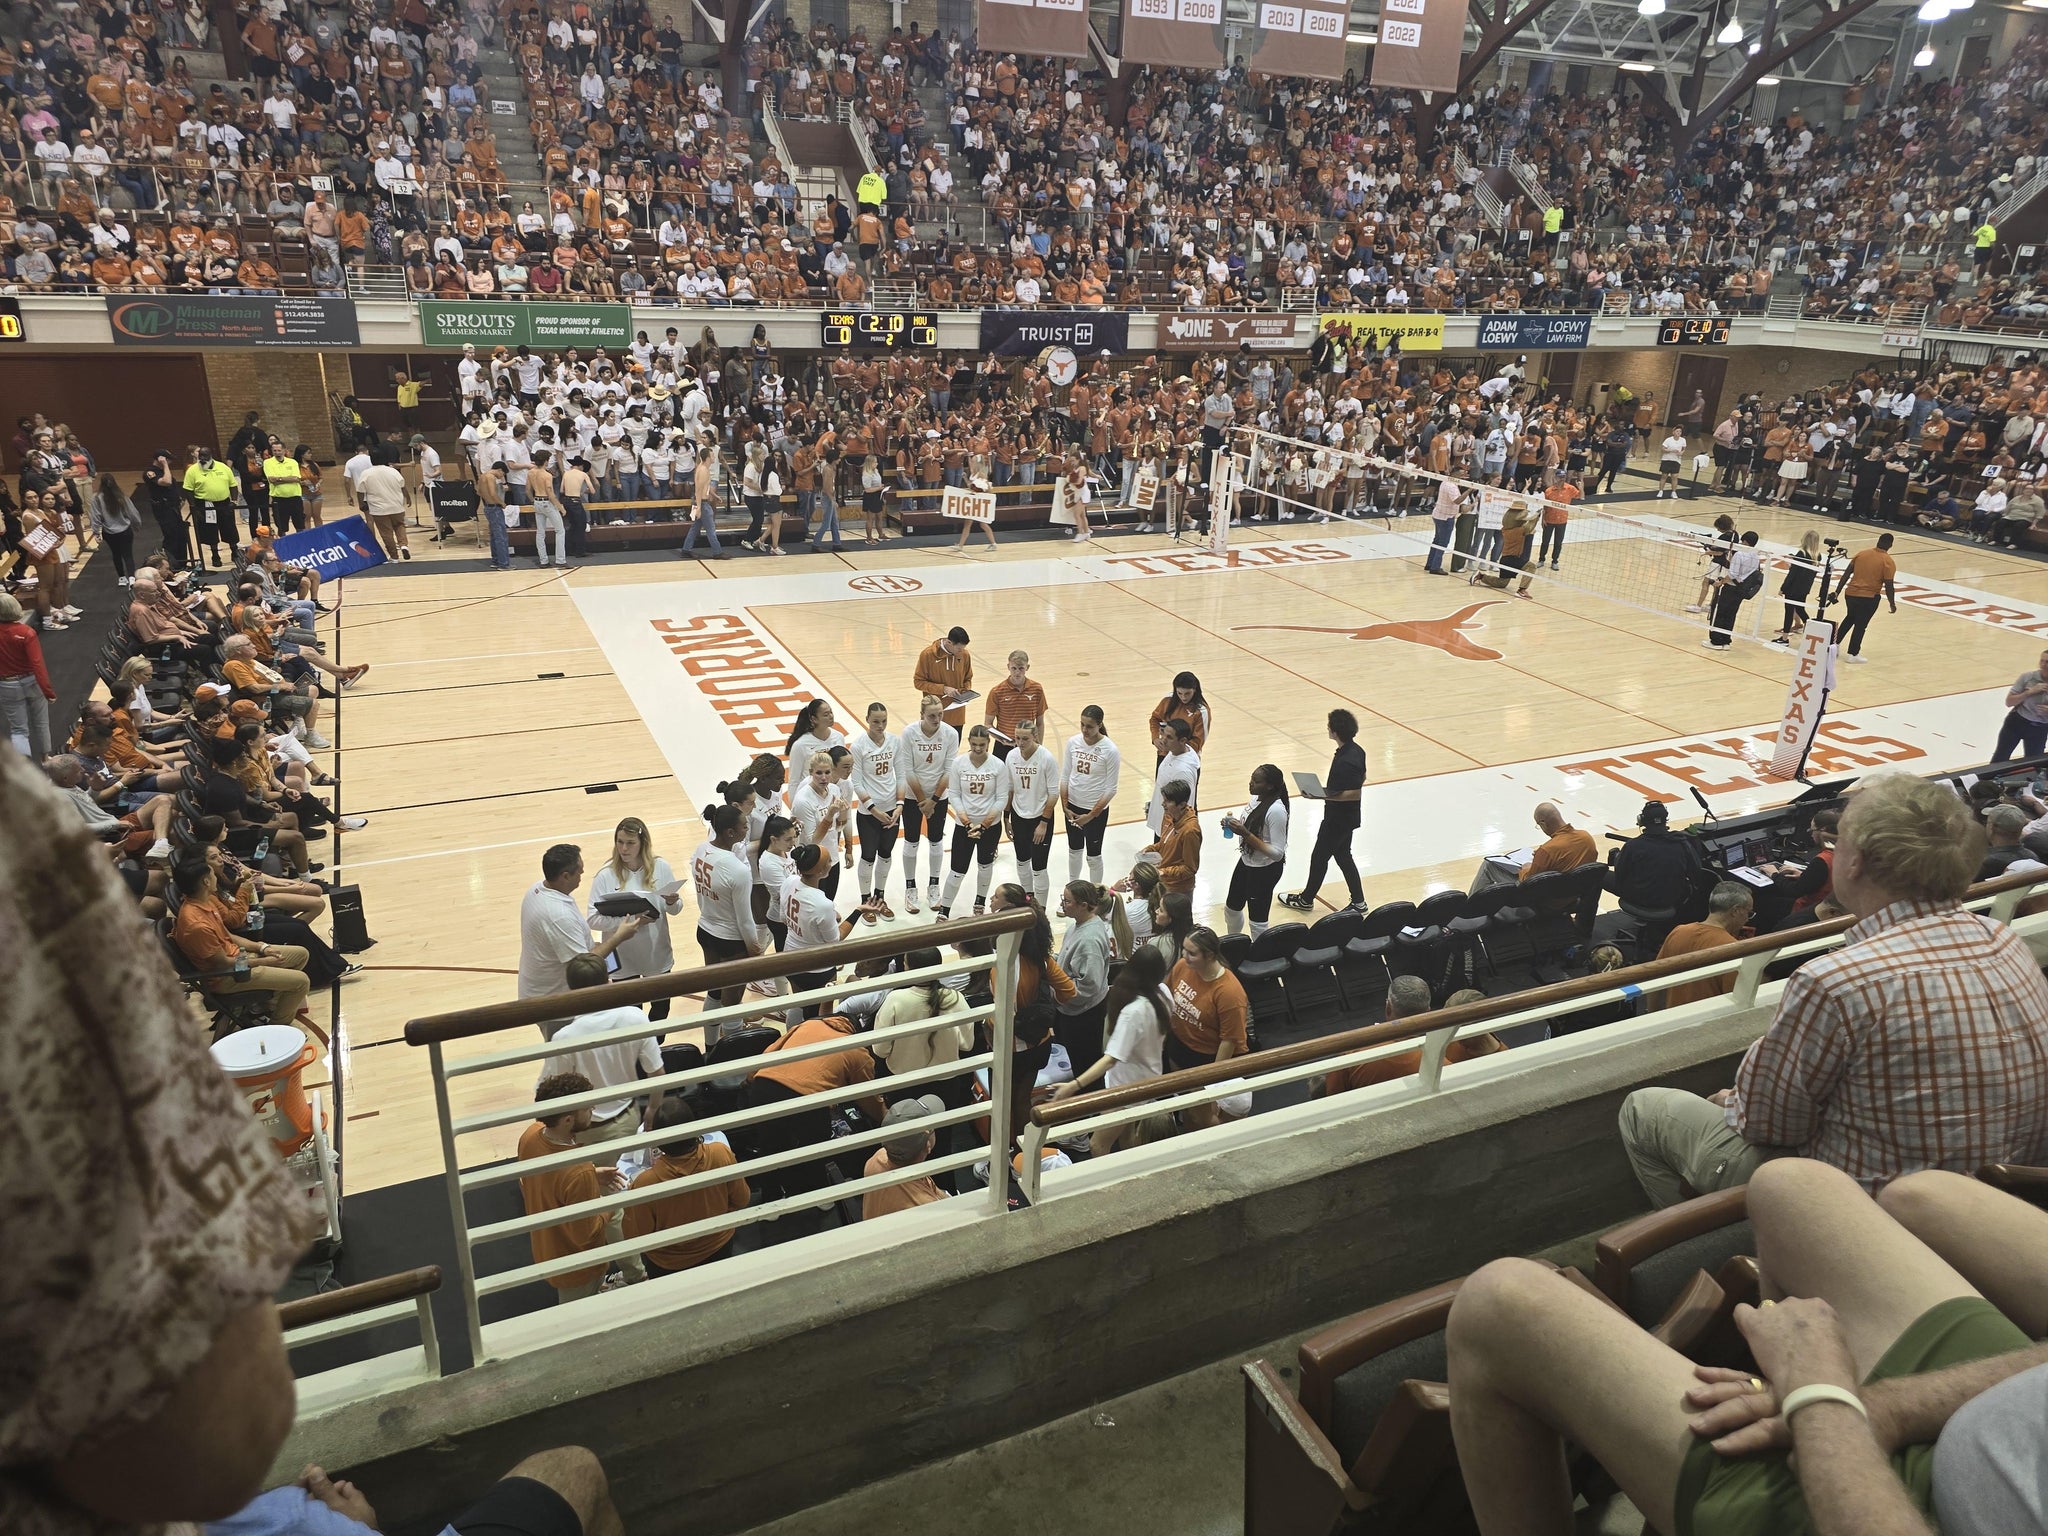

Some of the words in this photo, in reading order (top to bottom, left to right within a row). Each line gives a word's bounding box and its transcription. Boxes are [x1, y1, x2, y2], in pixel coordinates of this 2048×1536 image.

[1139, 0, 1168, 14] 1993
[1184, 2, 1215, 19] 2008
[1268, 10, 1295, 27] 2013
[1310, 16, 1337, 33] 2018
[1388, 26, 1416, 42] 2022
[317, 181, 326, 189] 31
[398, 185, 408, 193] 32
[176, 305, 262, 320] Minuteman
[1, 316, 19, 336] 0
[176, 319, 217, 331] Press
[436, 314, 516, 328] SPROUTS
[535, 317, 559, 325] PROUD
[559, 318, 591, 326] SPONSOR
[591, 318, 601, 326] OF
[829, 315, 855, 326] TEXAS
[869, 315, 904, 332] 2:10
[1485, 321, 1518, 332] ADAM
[1548, 321, 1587, 333] LOEWY
[441, 328, 478, 336] FARMERS
[536, 327, 558, 335] TEXAS
[559, 327, 590, 335] WOMEN'S
[591, 328, 625, 336] ATHLETICS
[1019, 327, 1073, 341] TRUIST
[1184, 319, 1214, 338] ONE
[1357, 327, 1378, 337] REAL
[1379, 327, 1406, 337] TEXAS
[840, 327, 851, 344] 0
[886, 334, 894, 345] 2
[925, 328, 936, 345] 0
[1481, 333, 1519, 343] LOEWY
[1546, 334, 1564, 343] LAW
[1564, 334, 1582, 343] FIRM
[1672, 330, 1680, 342] 0
[1721, 330, 1729, 342] 0
[1136, 478, 1157, 506] WE
[440, 499, 469, 507] molten
[947, 495, 992, 518] FIGHT
[1209, 481, 1221, 549] TEXAS
[285, 544, 349, 571] merican
[1102, 543, 1353, 575] TEXAS
[1782, 634, 1824, 745] TEXAS
[918, 743, 943, 752] TEXAS
[870, 751, 893, 762] TEXAS
[926, 752, 933, 764] 4
[1075, 751, 1098, 763] TEXAS
[1553, 720, 1928, 804] TEXAS
[875, 761, 889, 776] 26
[1015, 767, 1037, 775] TEXAS
[1076, 760, 1091, 775] 23
[966, 773, 992, 782] TEXAS
[1020, 775, 1031, 789] 17
[969, 782, 985, 795] 27
[695, 857, 714, 889] 55
[786, 894, 801, 924] 12
[1176, 979, 1198, 1001] TEXAS
